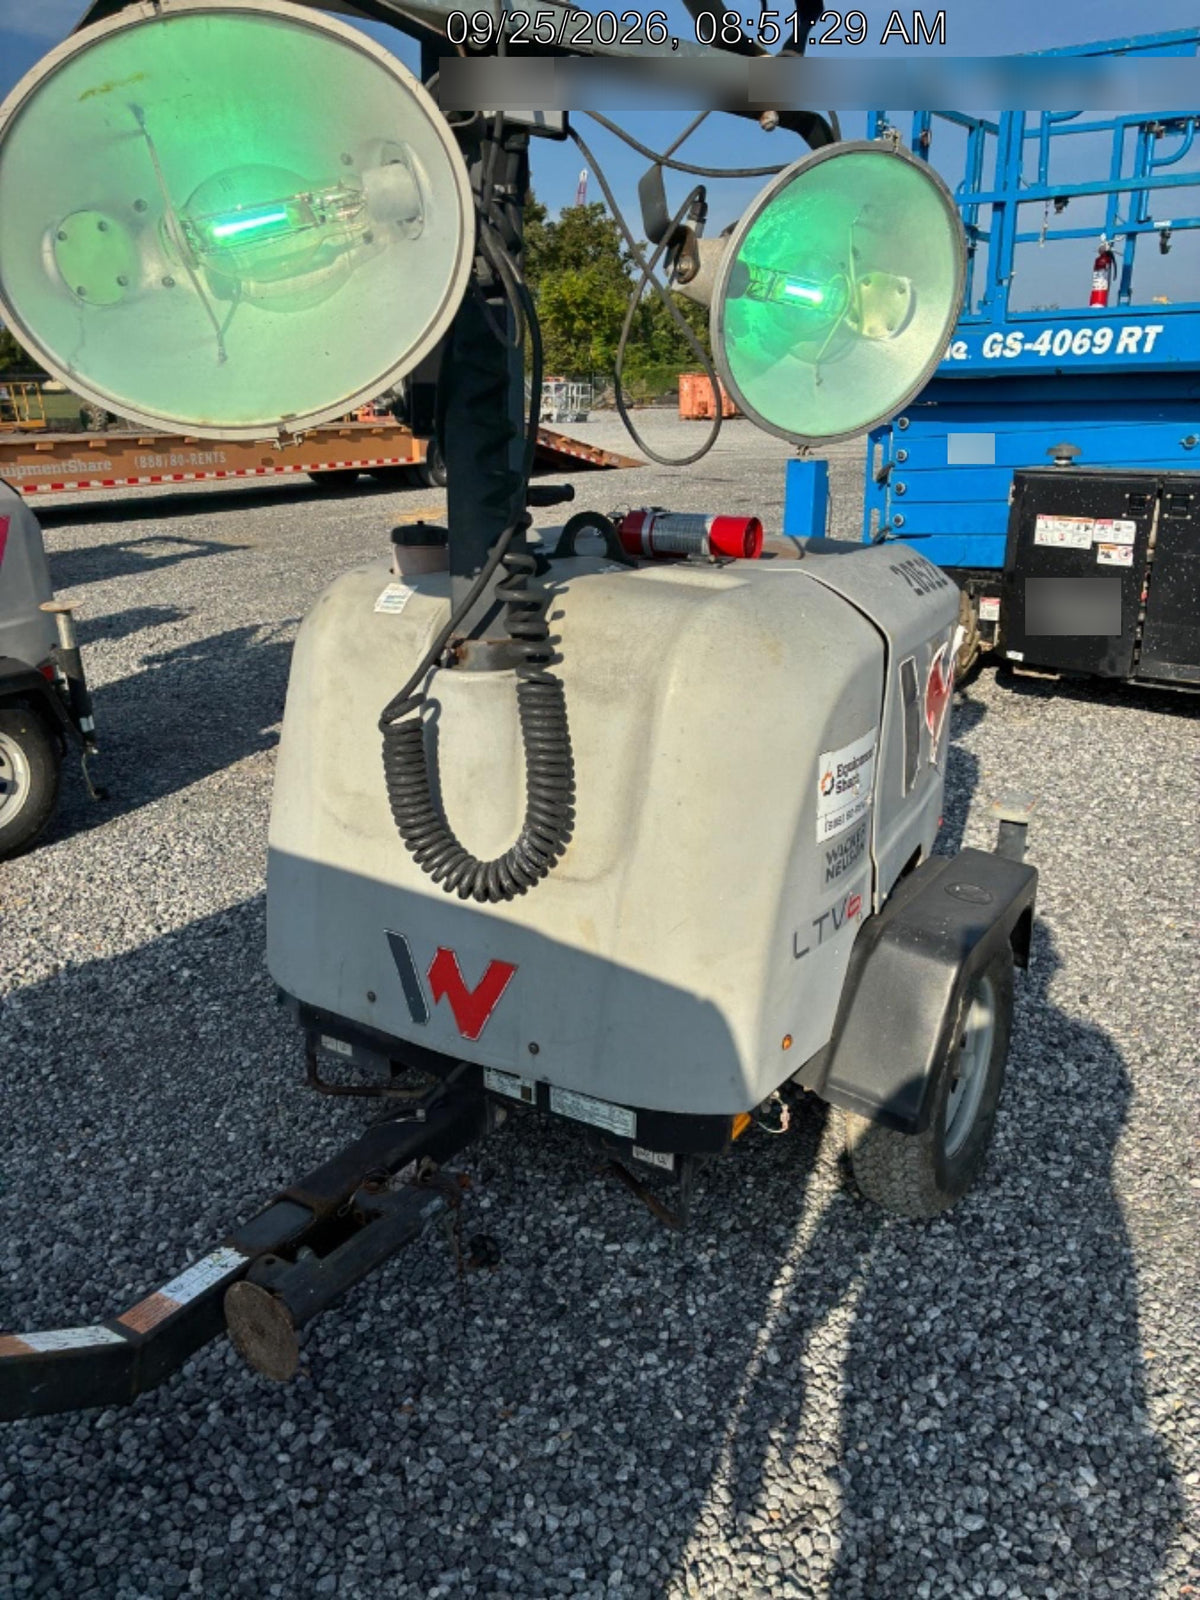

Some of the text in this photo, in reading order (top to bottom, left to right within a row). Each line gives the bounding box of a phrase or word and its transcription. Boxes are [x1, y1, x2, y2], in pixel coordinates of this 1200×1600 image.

[983, 327, 1114, 359] GS-4069
[1115, 325, 1164, 355] RT
[170, 451, 226, 466] 80-RENTS
